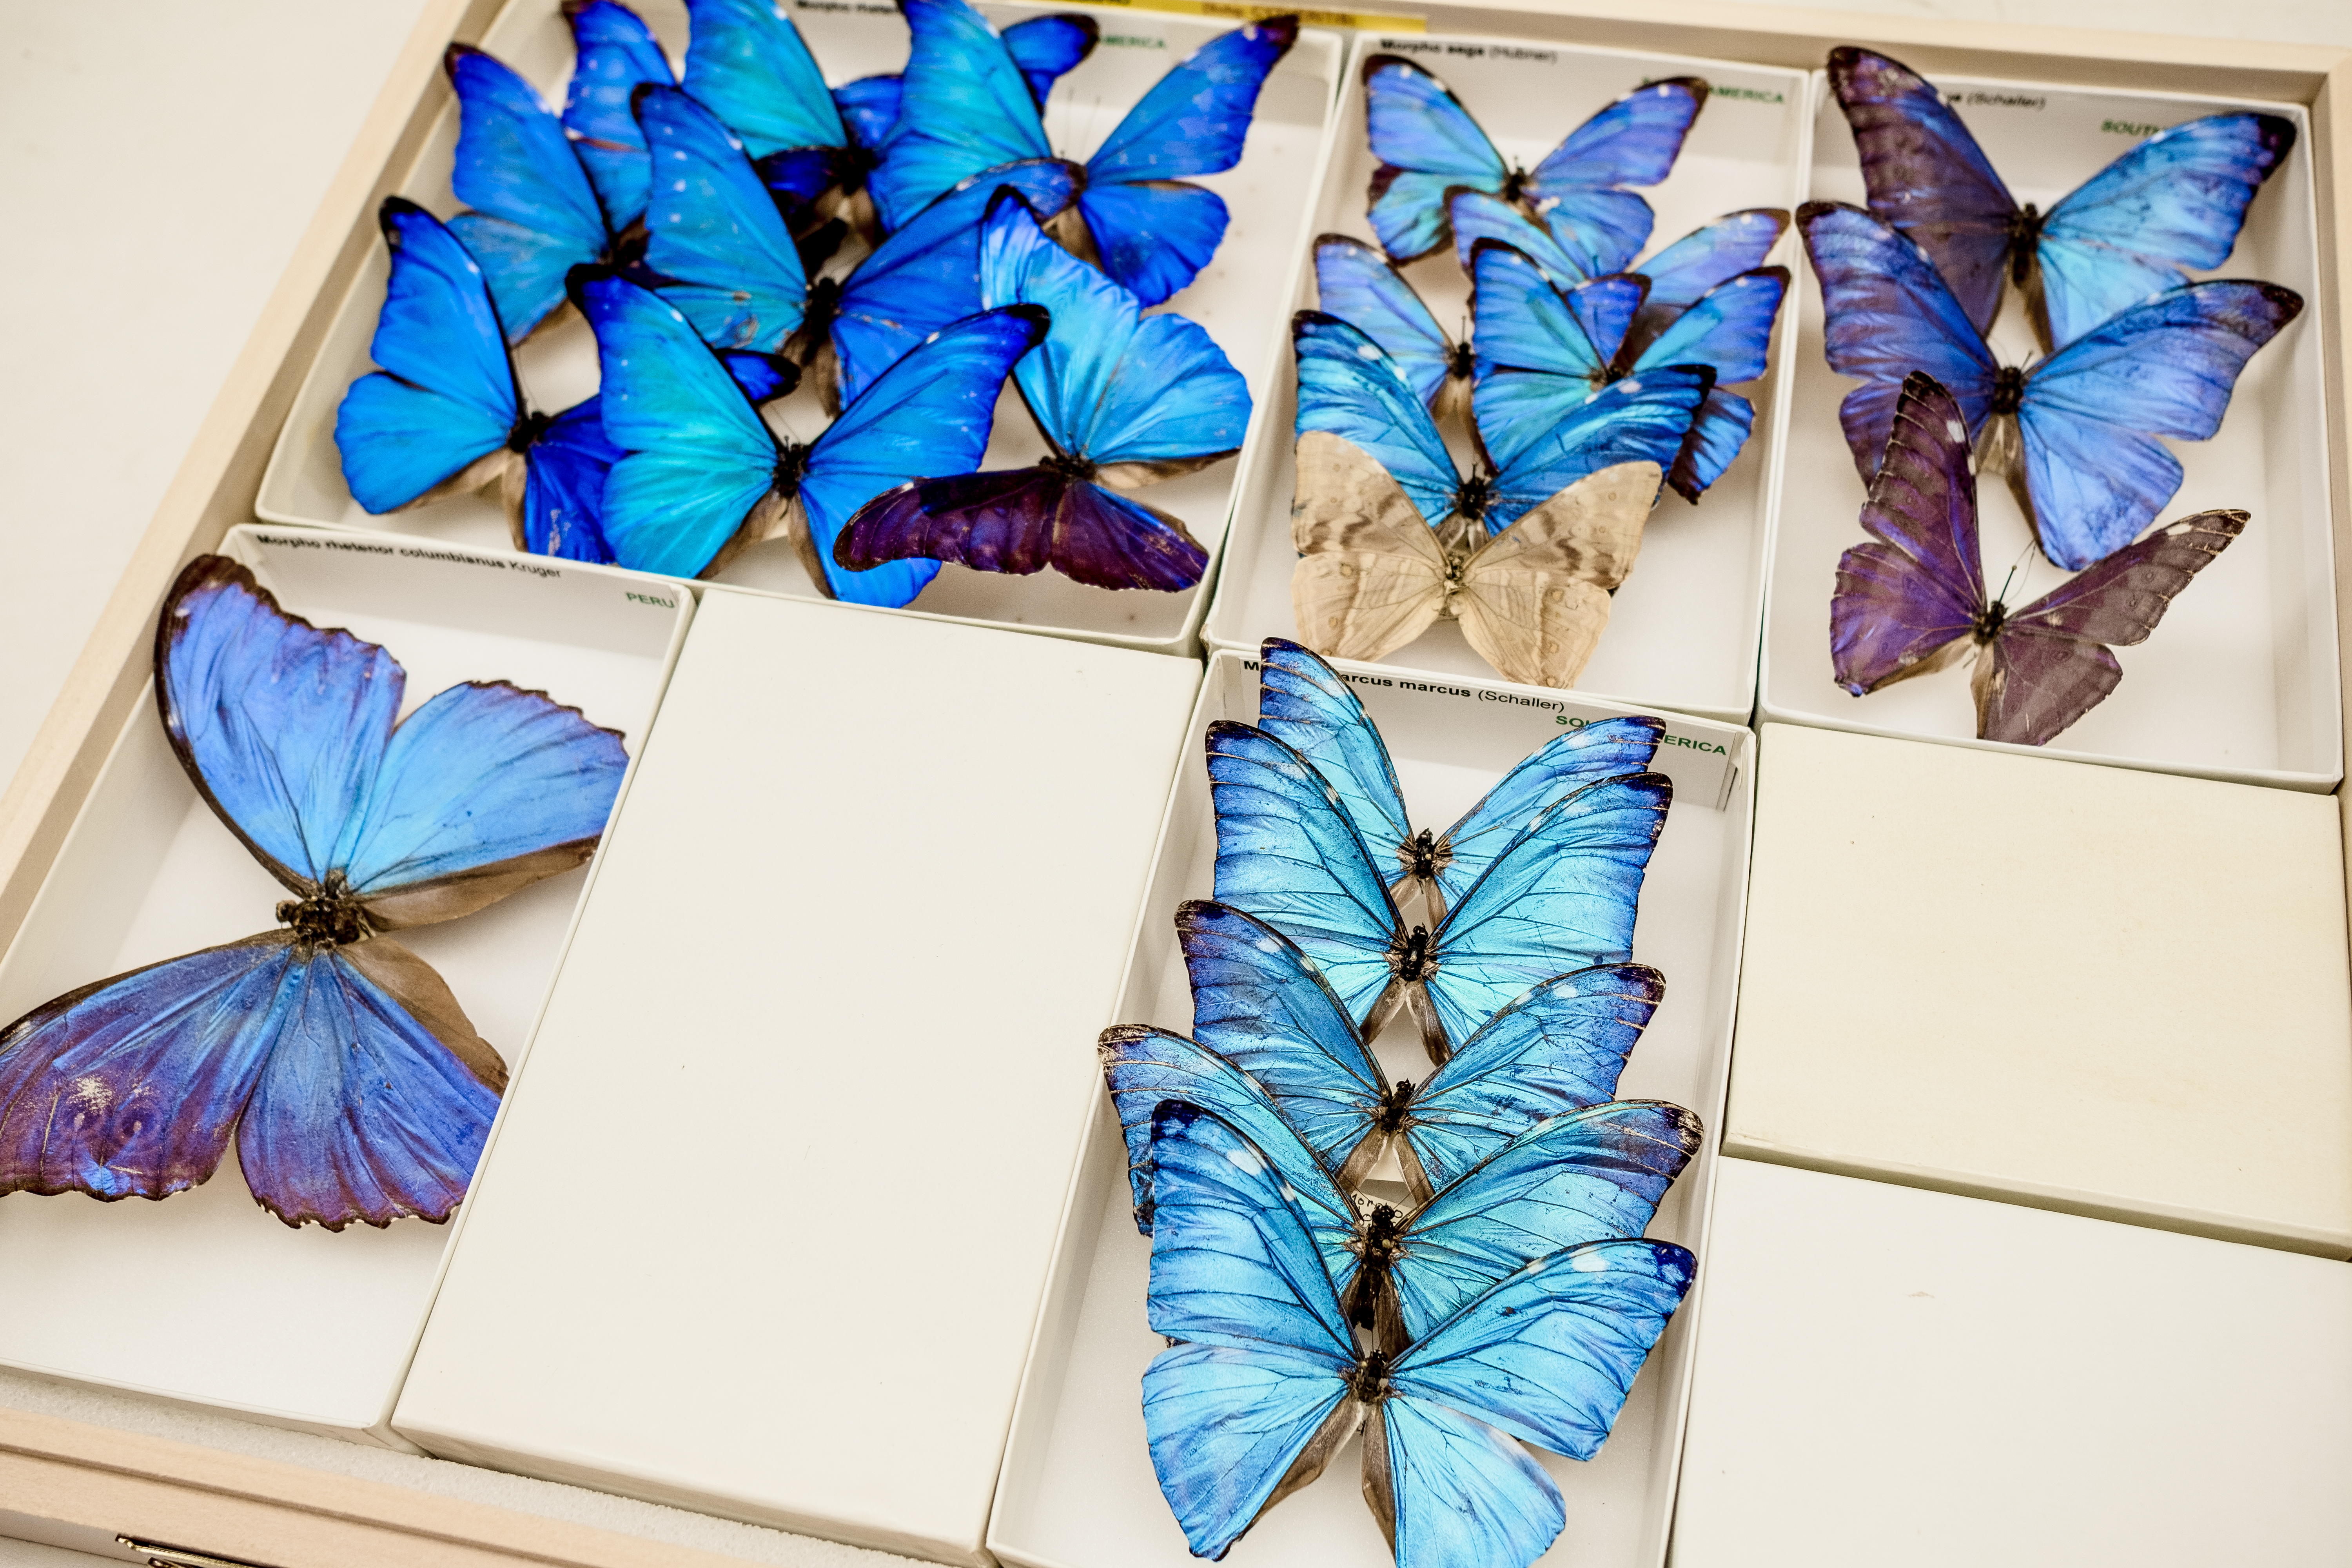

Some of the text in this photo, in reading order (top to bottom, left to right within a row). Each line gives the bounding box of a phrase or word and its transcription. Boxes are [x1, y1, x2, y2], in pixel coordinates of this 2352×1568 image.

[1101, 34, 1167, 49] MERICA
[257, 534, 321, 548] Morpho
[400, 548, 505, 568] columbianus
[509, 561, 561, 578] Kruger
[626, 592, 675, 608] PERU
[1340, 674, 1564, 713] arcus marcus (Schaller)
[1664, 735, 1726, 755] ERICA
